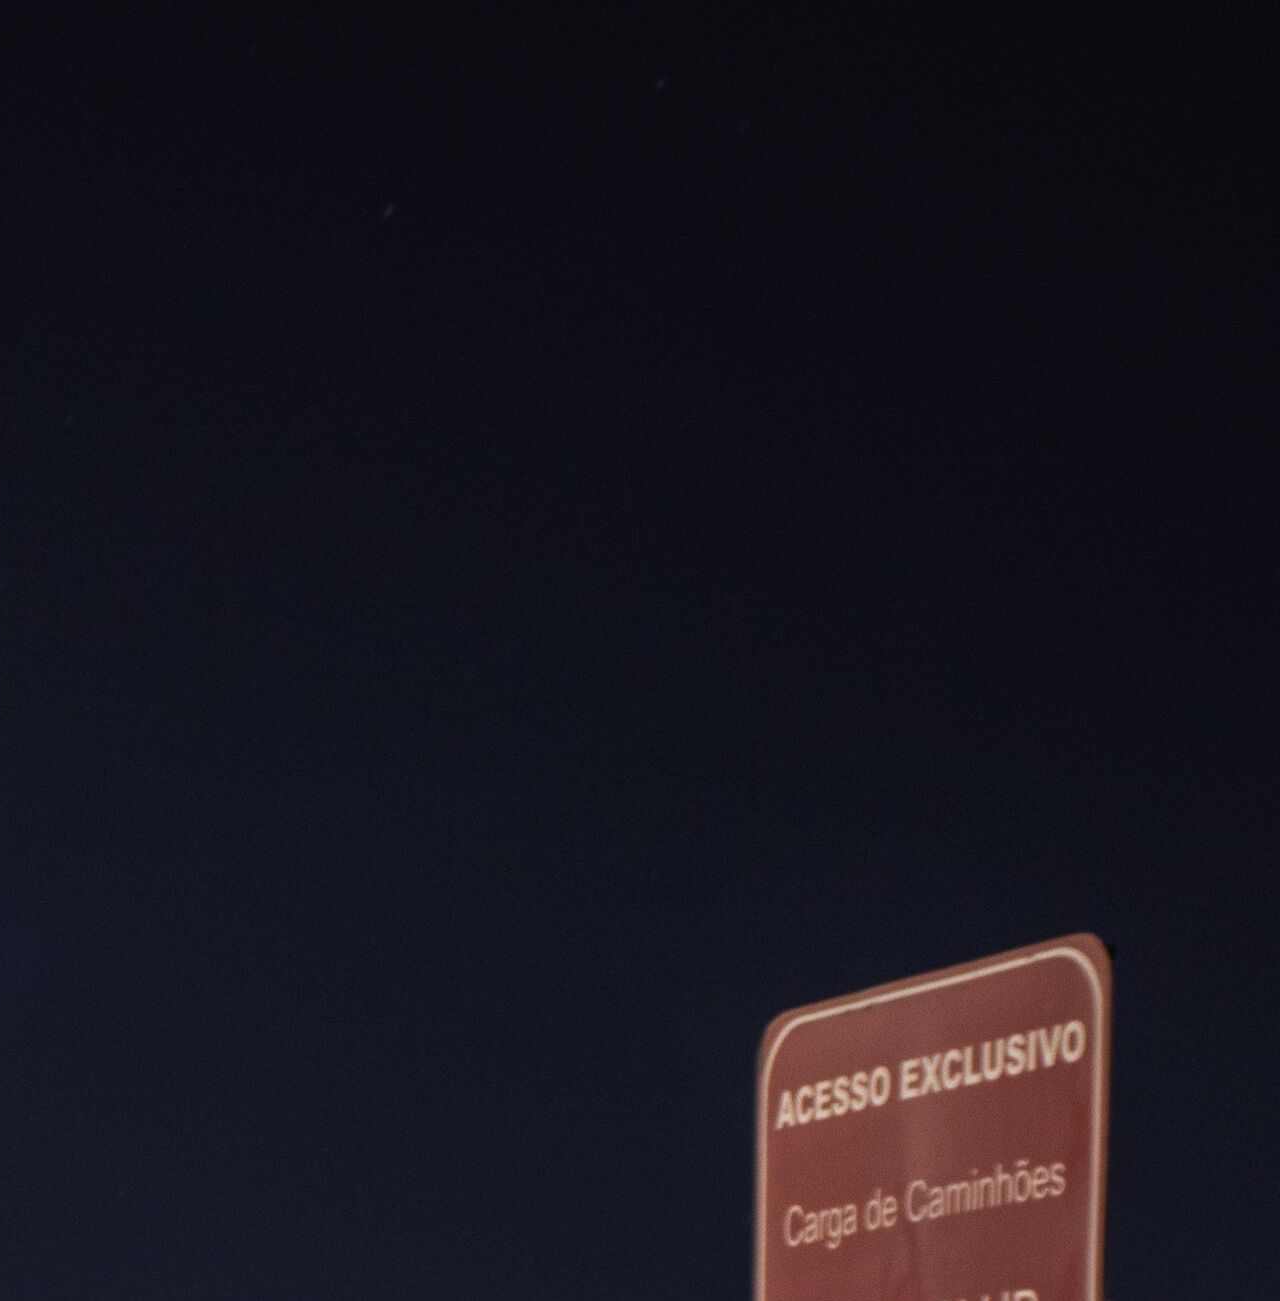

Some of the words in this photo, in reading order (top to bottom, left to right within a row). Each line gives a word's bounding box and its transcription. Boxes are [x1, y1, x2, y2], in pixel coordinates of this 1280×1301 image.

[774, 1066, 892, 1130] ACESSO
[898, 1018, 1088, 1101] EXCLUSIVO
[783, 1204, 858, 1250] Carga
[863, 1187, 898, 1231] de
[905, 1158, 1067, 1222] Caminhões
